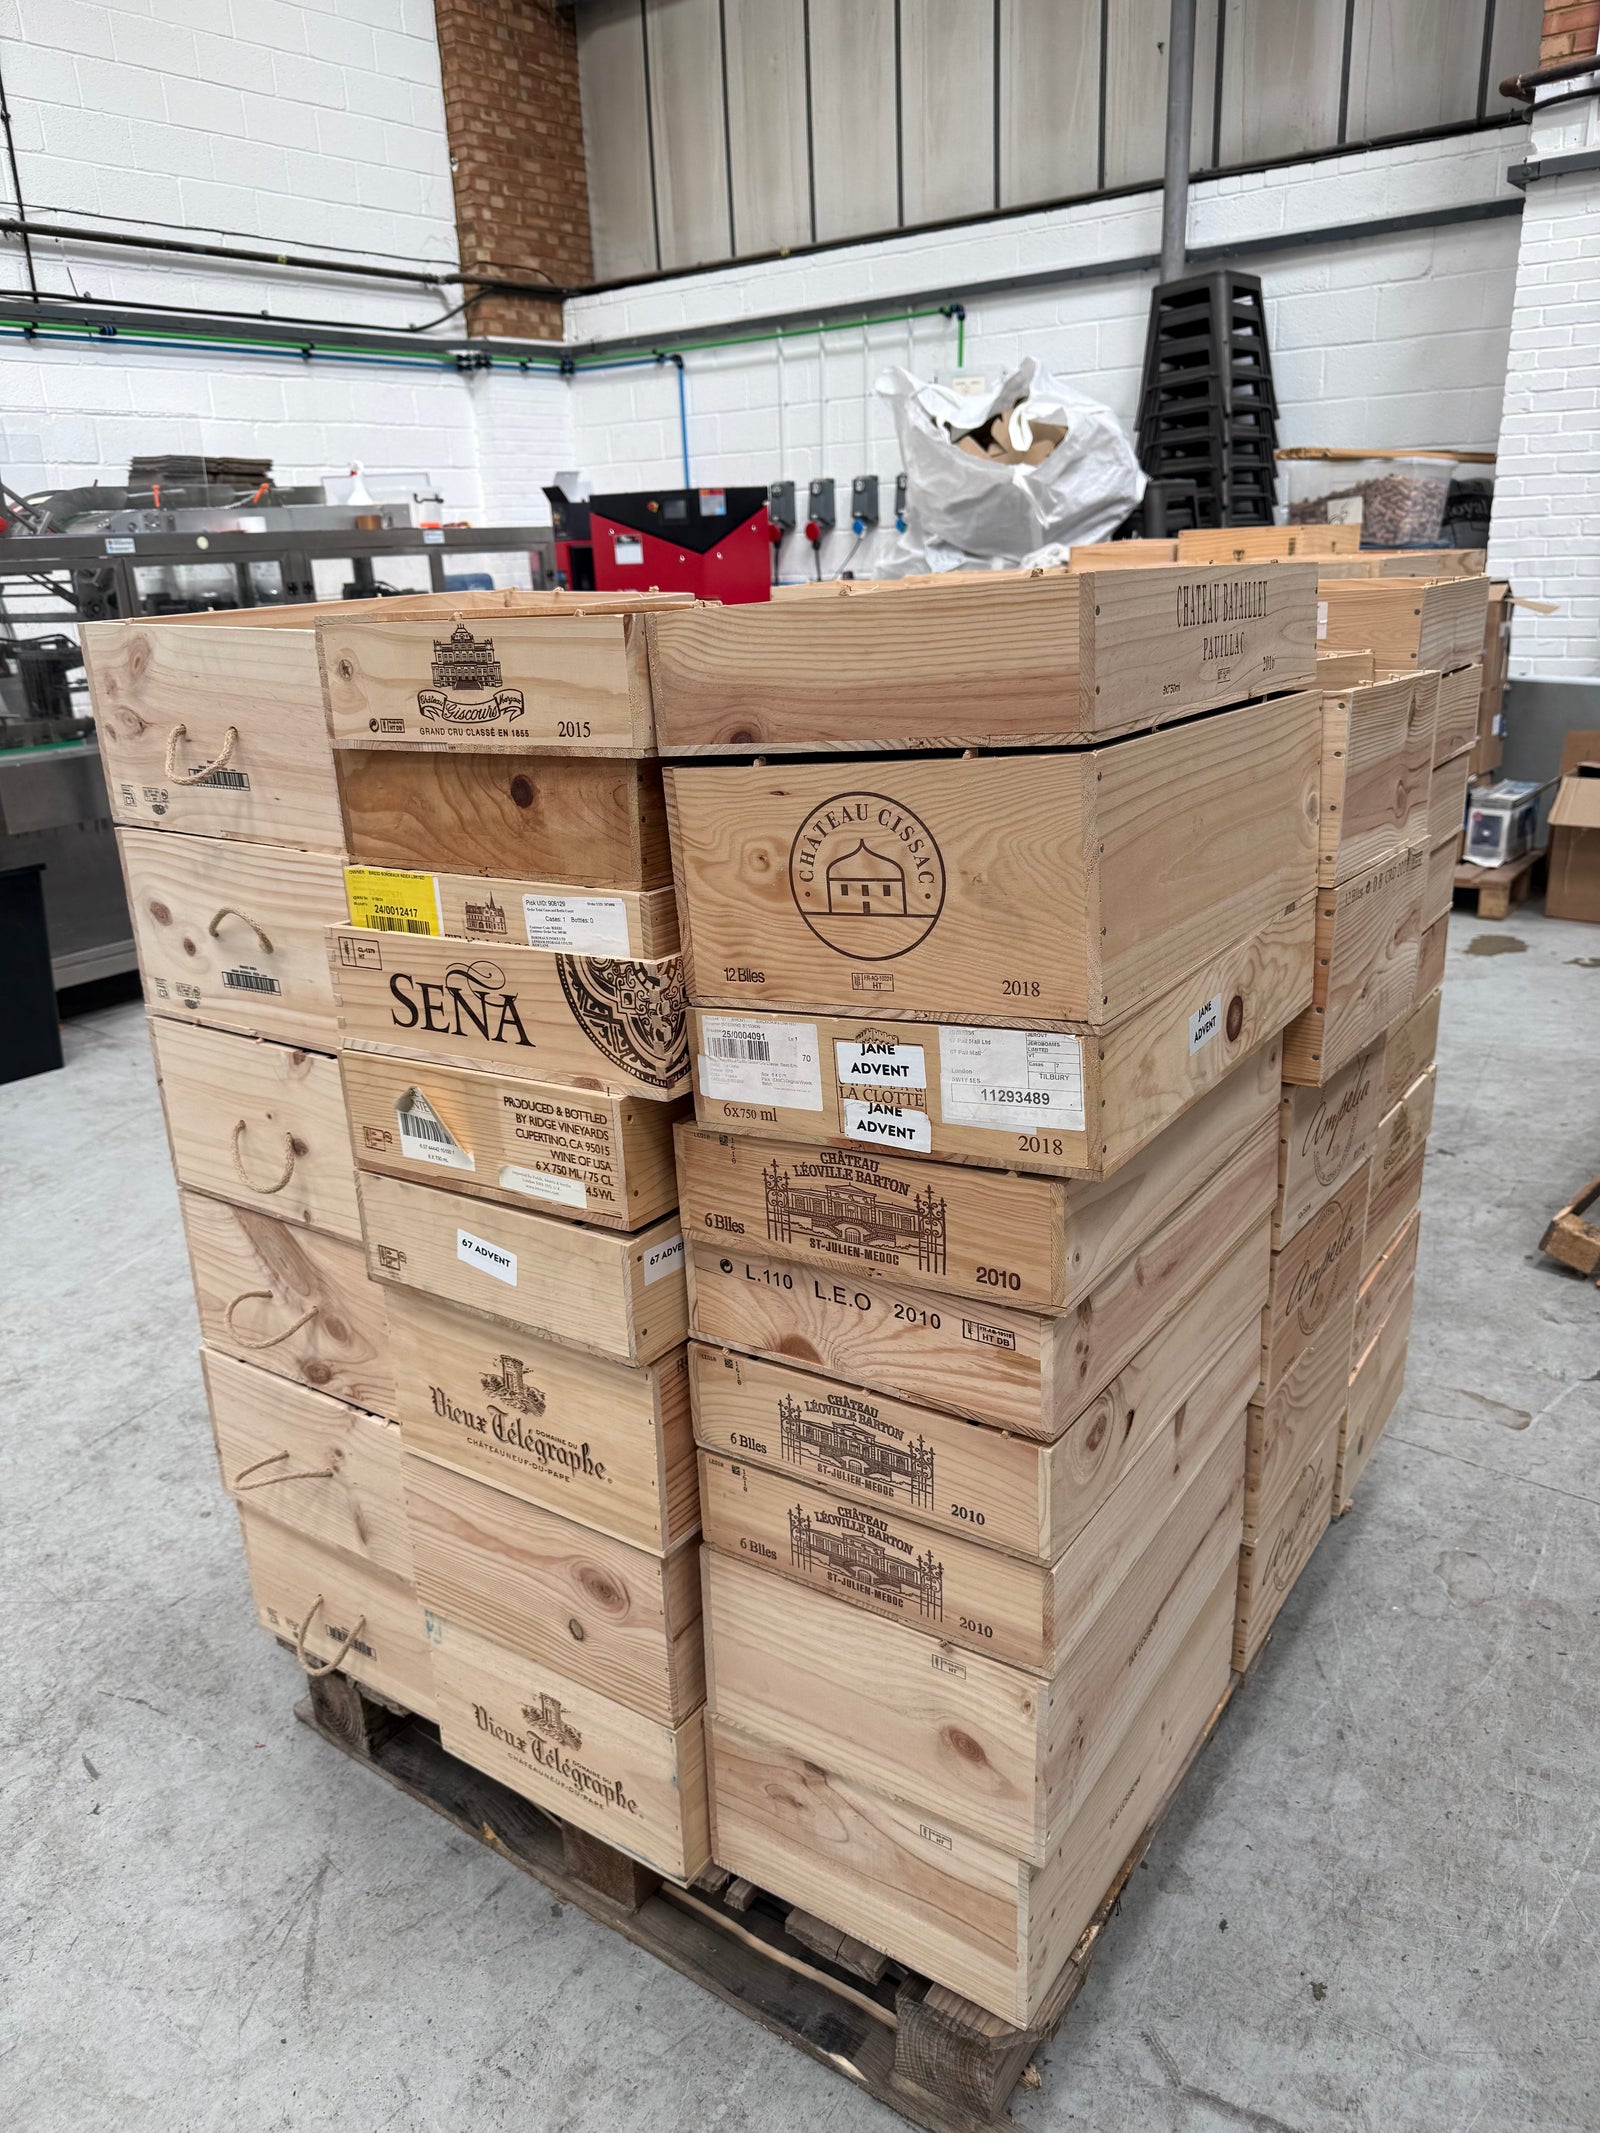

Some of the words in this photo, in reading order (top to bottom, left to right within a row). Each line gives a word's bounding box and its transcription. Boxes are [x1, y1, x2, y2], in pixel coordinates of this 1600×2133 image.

[1176, 584, 1220, 628] CHATEAU
[1203, 632, 1245, 661] PAUILLAC
[444, 703, 499, 721] Giscours
[419, 727, 445, 737] GRAND
[447, 728, 464, 738] CRU
[466, 726, 495, 738] CLASSÉ
[498, 730, 509, 738] EN
[511, 730, 530, 739] 1855
[557, 721, 592, 739] 2015
[799, 803, 870, 883] CHÂTEAU
[877, 808, 936, 886] CISSAC
[374, 904, 418, 918] 24/0012417
[545, 915, 562, 923] Cases:
[723, 966, 736, 983] 12
[872, 982, 883, 990] HT
[1001, 979, 1041, 997] 2018
[1198, 1000, 1212, 1023] JANE
[721, 1029, 766, 1041] 25/0004091
[1193, 1015, 1217, 1045] ADVENT
[802, 1054, 811, 1062] 70
[860, 1042, 896, 1056] JANE
[850, 1061, 910, 1078] ADVENT
[1039, 1073, 1070, 1081] TILBURY
[839, 1085, 859, 1101] LA
[862, 1088, 924, 1107] CLOTTE
[980, 1088, 1050, 1106] 11293489
[503, 1096, 554, 1115] PRODUCED
[556, 1106, 563, 1116] &
[565, 1108, 608, 1125] BOTTLED
[723, 1102, 757, 1120] 6x750
[760, 1107, 777, 1122] ml
[867, 1102, 903, 1117] JANE
[515, 1113, 526, 1125] BY
[529, 1115, 557, 1131] RIDGE
[558, 1122, 609, 1141] VINEYARDS
[856, 1119, 916, 1140] ADVENT
[515, 1128, 568, 1148] CUPERTINO,
[568, 1139, 584, 1151] CA
[585, 1142, 610, 1156] 95015
[1018, 1135, 1064, 1156] 2018
[550, 1150, 577, 1165] WINE
[578, 1155, 592, 1167] OF
[593, 1159, 613, 1172] USA
[820, 1150, 880, 1173] CHÂTEAU
[535, 1160, 542, 1171] 6
[542, 1161, 551, 1173] X
[552, 1163, 567, 1176] 750
[568, 1169, 582, 1180] ML
[588, 1171, 599, 1183] 75
[600, 1174, 614, 1187] CL
[792, 1162, 854, 1181] LÉOVILLE
[855, 1170, 910, 1196] BARTON
[704, 1212, 713, 1228] 6
[462, 1238, 473, 1248] 67
[475, 1245, 511, 1268] ADVENT
[649, 1253, 660, 1266] 67
[808, 1237, 900, 1266] ST-JULIEN-MEDOC
[975, 1266, 1021, 1291] 2010
[745, 1263, 794, 1291] L.110
[814, 1279, 872, 1312] L.E.O
[893, 1303, 942, 1330] 2010
[982, 1333, 994, 1342] HT
[996, 1337, 1010, 1347] DB
[429, 1385, 487, 1434] Vieux
[827, 1394, 879, 1418] CHÂTEAU
[804, 1400, 857, 1424] LÉOVILLE
[858, 1410, 904, 1441] BARTON
[487, 1404, 607, 1480] Télégraphe
[536, 1429, 567, 1446] DOMAINE
[569, 1441, 578, 1450] DU
[730, 1432, 738, 1445] 6
[817, 1463, 894, 1497] ST-JULIEN-MEDOC
[837, 1505, 889, 1532] CHÂTEAU
[951, 1504, 986, 1526] 2010
[740, 1537, 748, 1550] 6
[814, 1511, 866, 1535] LÉOVILLE
[867, 1527, 914, 1556] BARTON
[827, 1571, 904, 1608] ST-JULIEN-MEDOC
[959, 1617, 994, 1638] 2010
[472, 1702, 527, 1753] Vieux
[526, 1730, 640, 1815] Télégraphe
[573, 1759, 601, 1777] DOMAINE
[602, 1775, 612, 1784] DU
